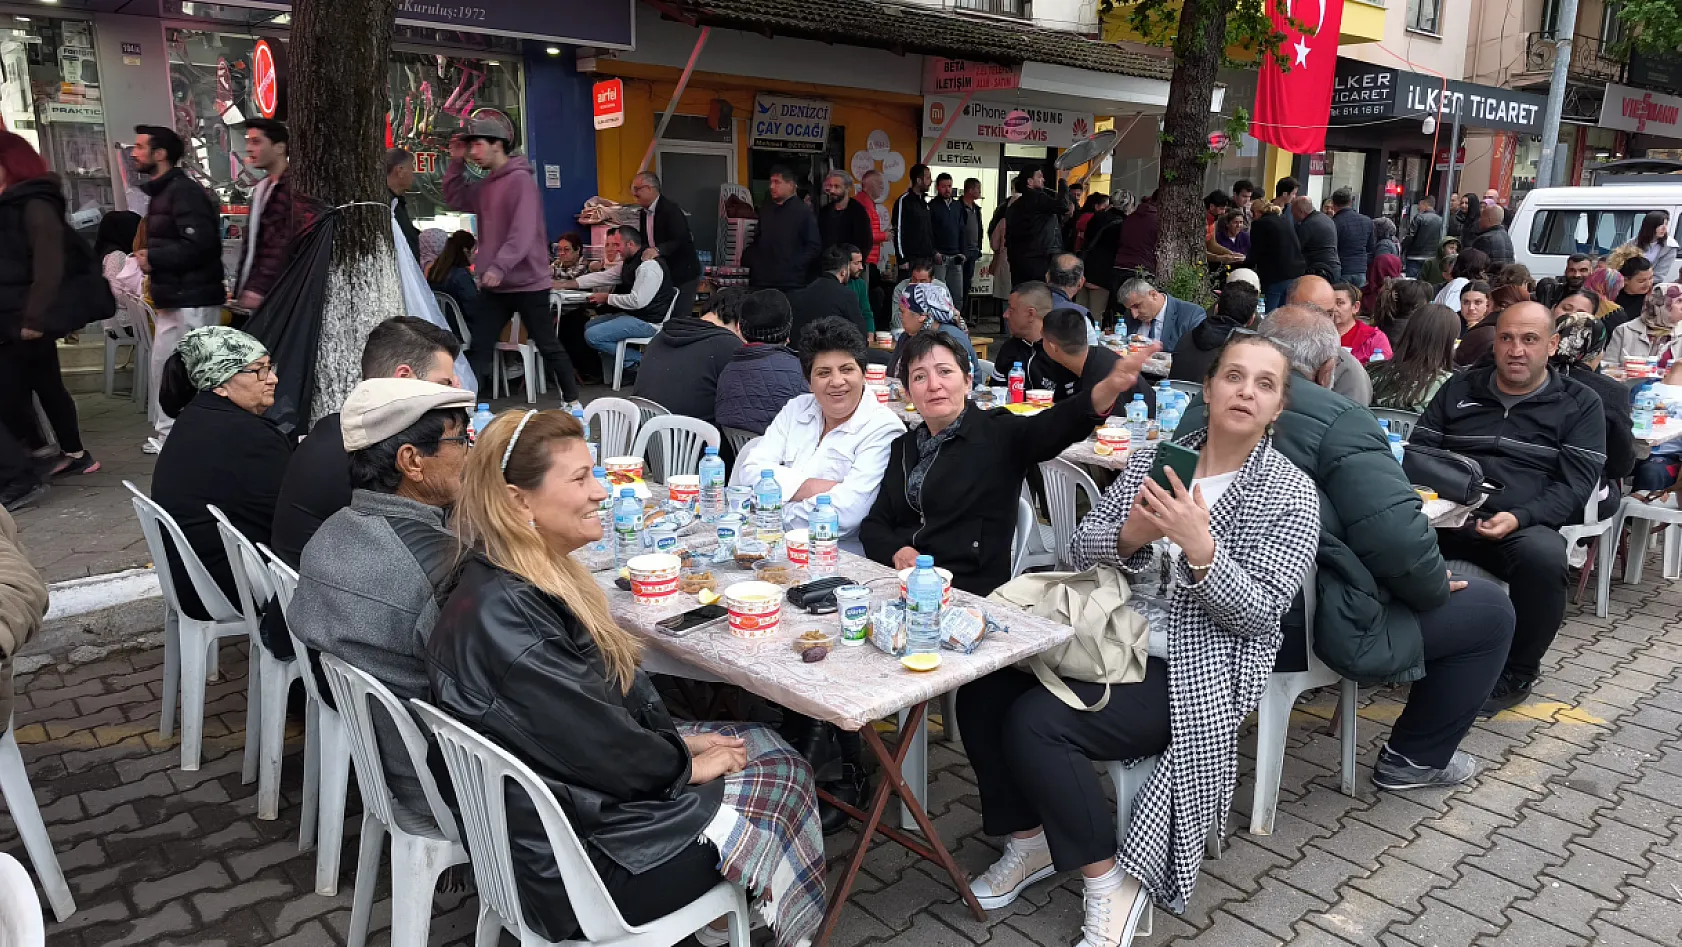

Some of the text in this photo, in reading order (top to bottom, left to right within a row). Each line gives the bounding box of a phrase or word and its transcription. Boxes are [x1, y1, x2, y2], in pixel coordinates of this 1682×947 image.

[944, 61, 965, 73] BETA
[1334, 73, 1391, 89] LKER
[780, 103, 829, 120] DENİZCİ
[972, 103, 1063, 124] iPhone MSUNG
[756, 121, 824, 138] ÇAY OCAĞI
[977, 124, 1008, 138] ETKİL
[947, 141, 974, 150] BETA
[938, 152, 982, 166] İLETİŞİM
